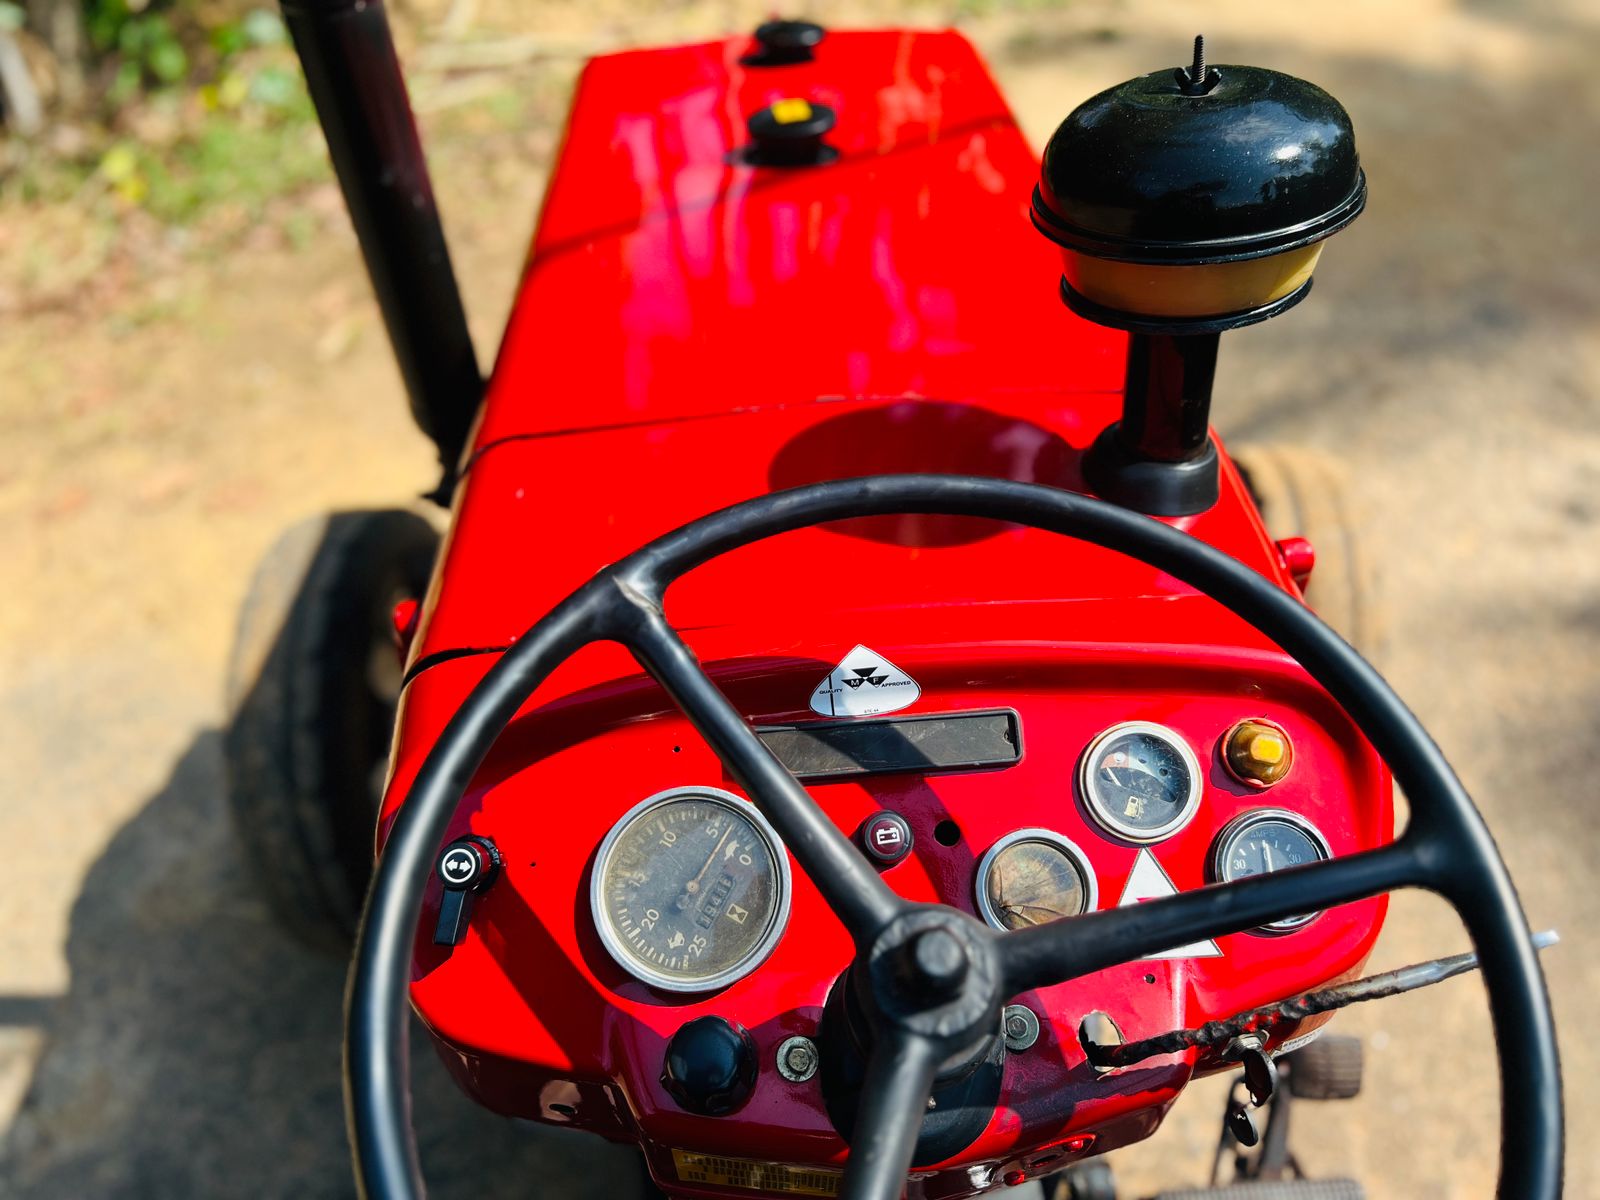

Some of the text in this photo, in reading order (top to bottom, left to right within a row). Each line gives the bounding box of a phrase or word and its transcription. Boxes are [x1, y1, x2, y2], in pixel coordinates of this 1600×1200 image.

[706, 825, 719, 838] 5
[1250, 829, 1275, 838] AMPS
[659, 831, 676, 848] 10
[739, 854, 752, 866] 0
[1233, 859, 1246, 870] 30
[1289, 853, 1302, 865] 30
[629, 871, 646, 887] 15
[641, 908, 660, 931] 20
[688, 934, 707, 957] 25
